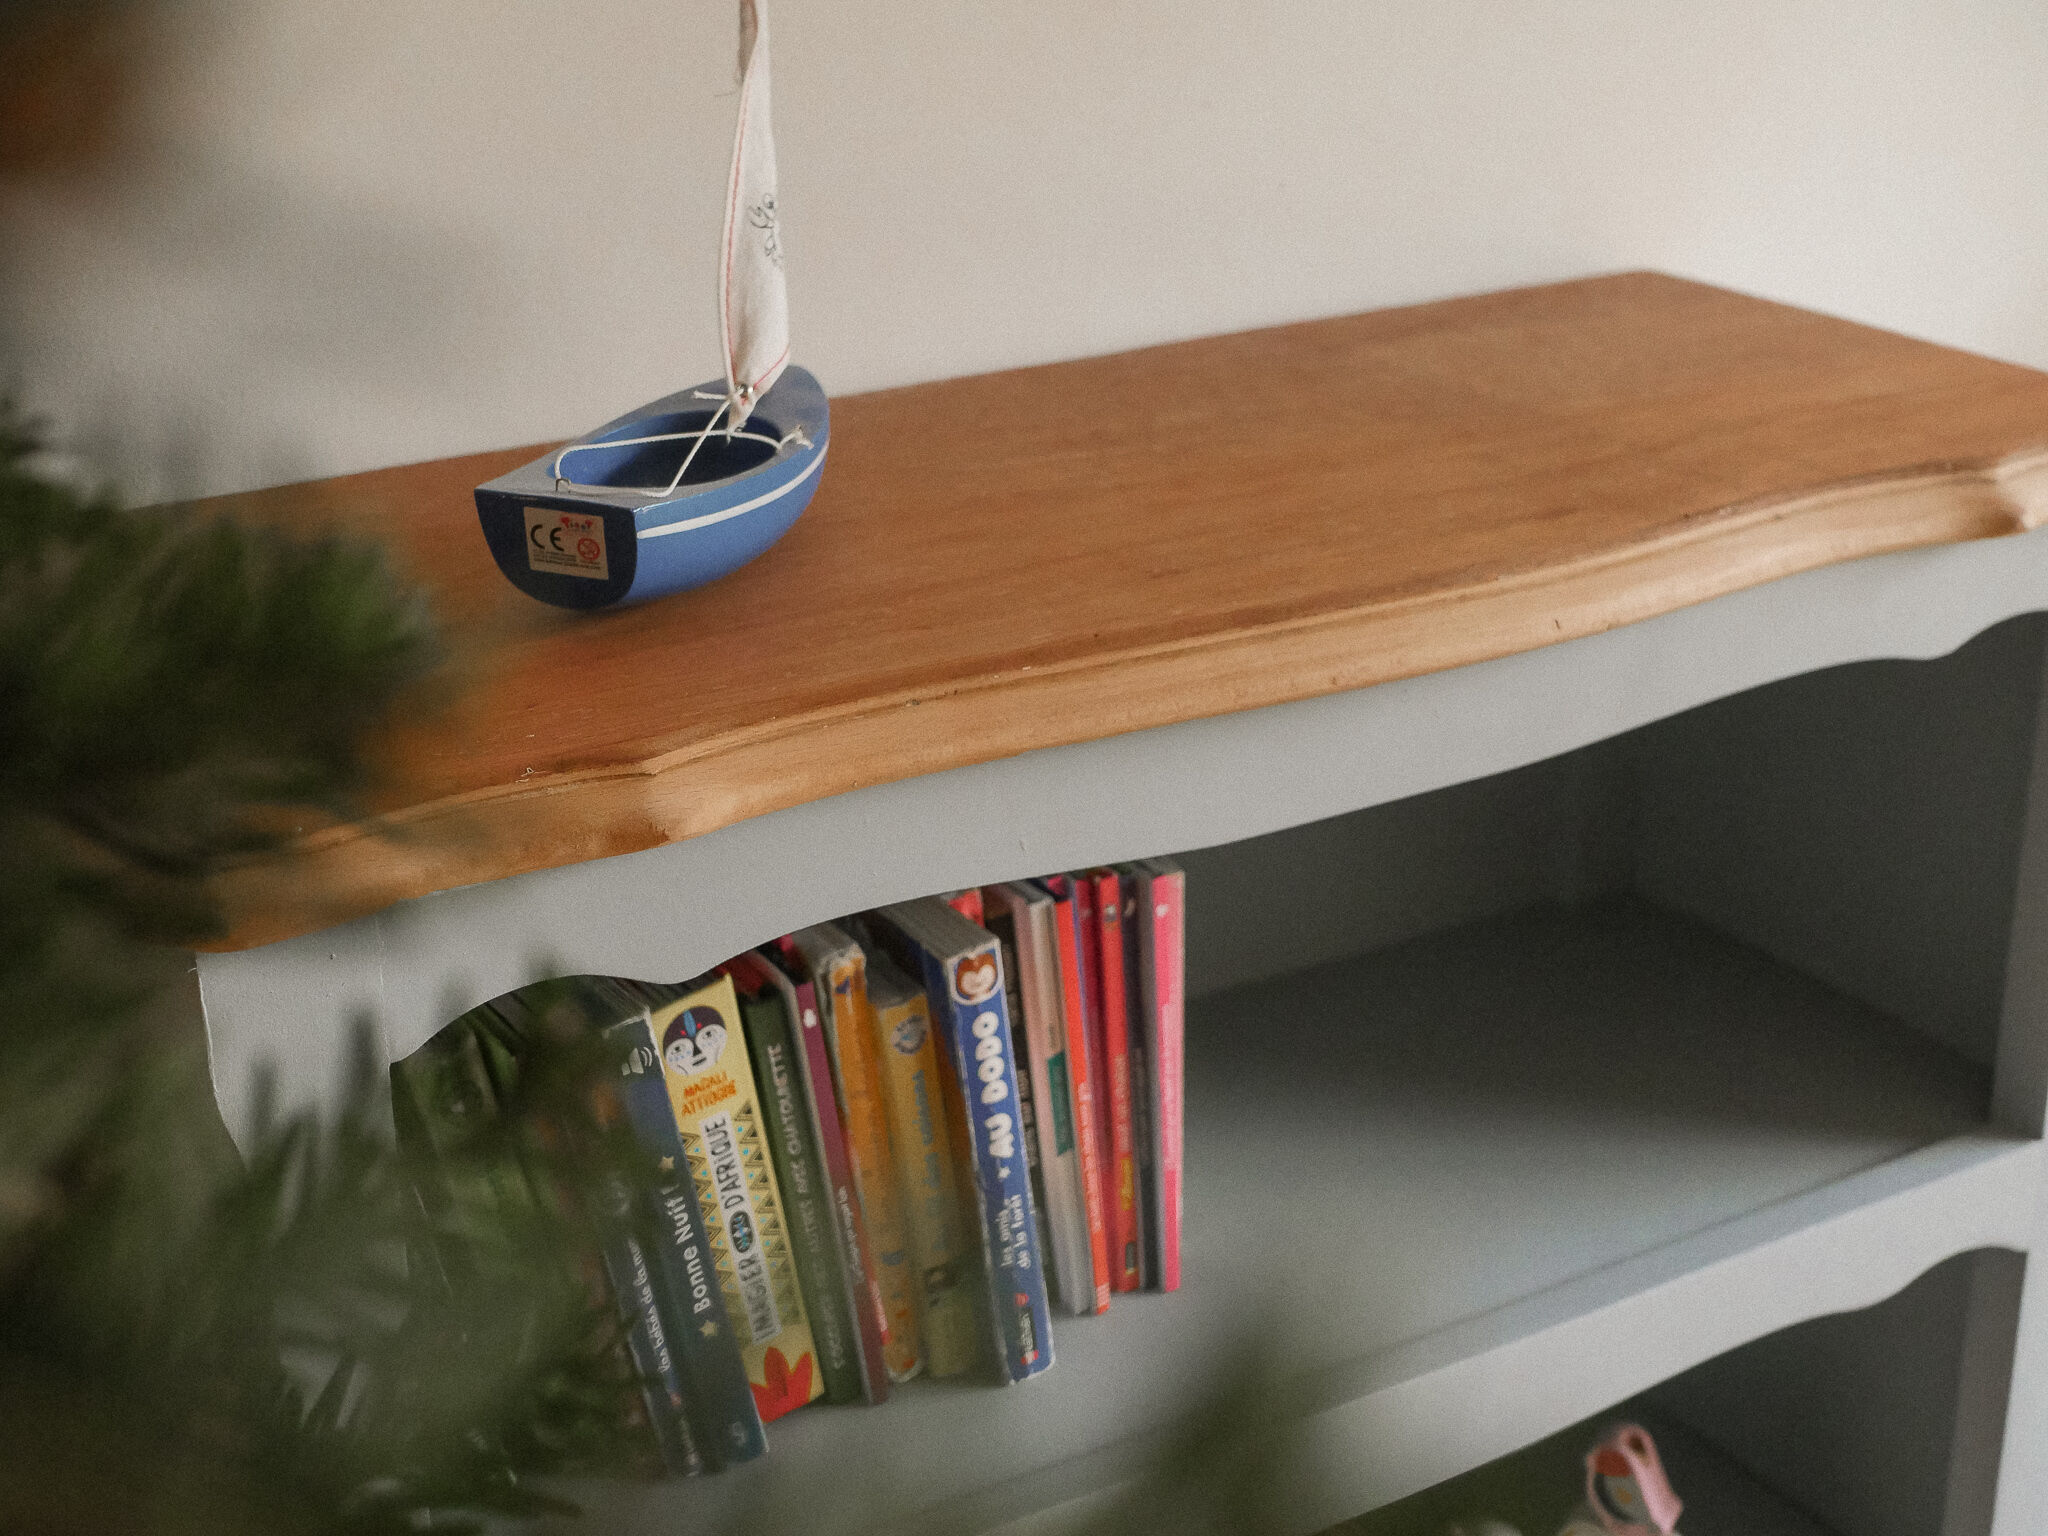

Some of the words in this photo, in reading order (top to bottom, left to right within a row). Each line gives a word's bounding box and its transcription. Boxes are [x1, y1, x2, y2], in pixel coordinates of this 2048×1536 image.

[972, 1011, 1008, 1104] DODO
[985, 1113, 1014, 1158] AU
[704, 1117, 744, 1210] D'AFRIQUE
[664, 1196, 694, 1245] Nuit
[1013, 1231, 1028, 1249] la
[633, 1265, 648, 1286] la
[683, 1245, 711, 1314] Bonne
[1017, 1250, 1031, 1270] de
[641, 1284, 653, 1305] de
[738, 1252, 775, 1344] IMAGIER
